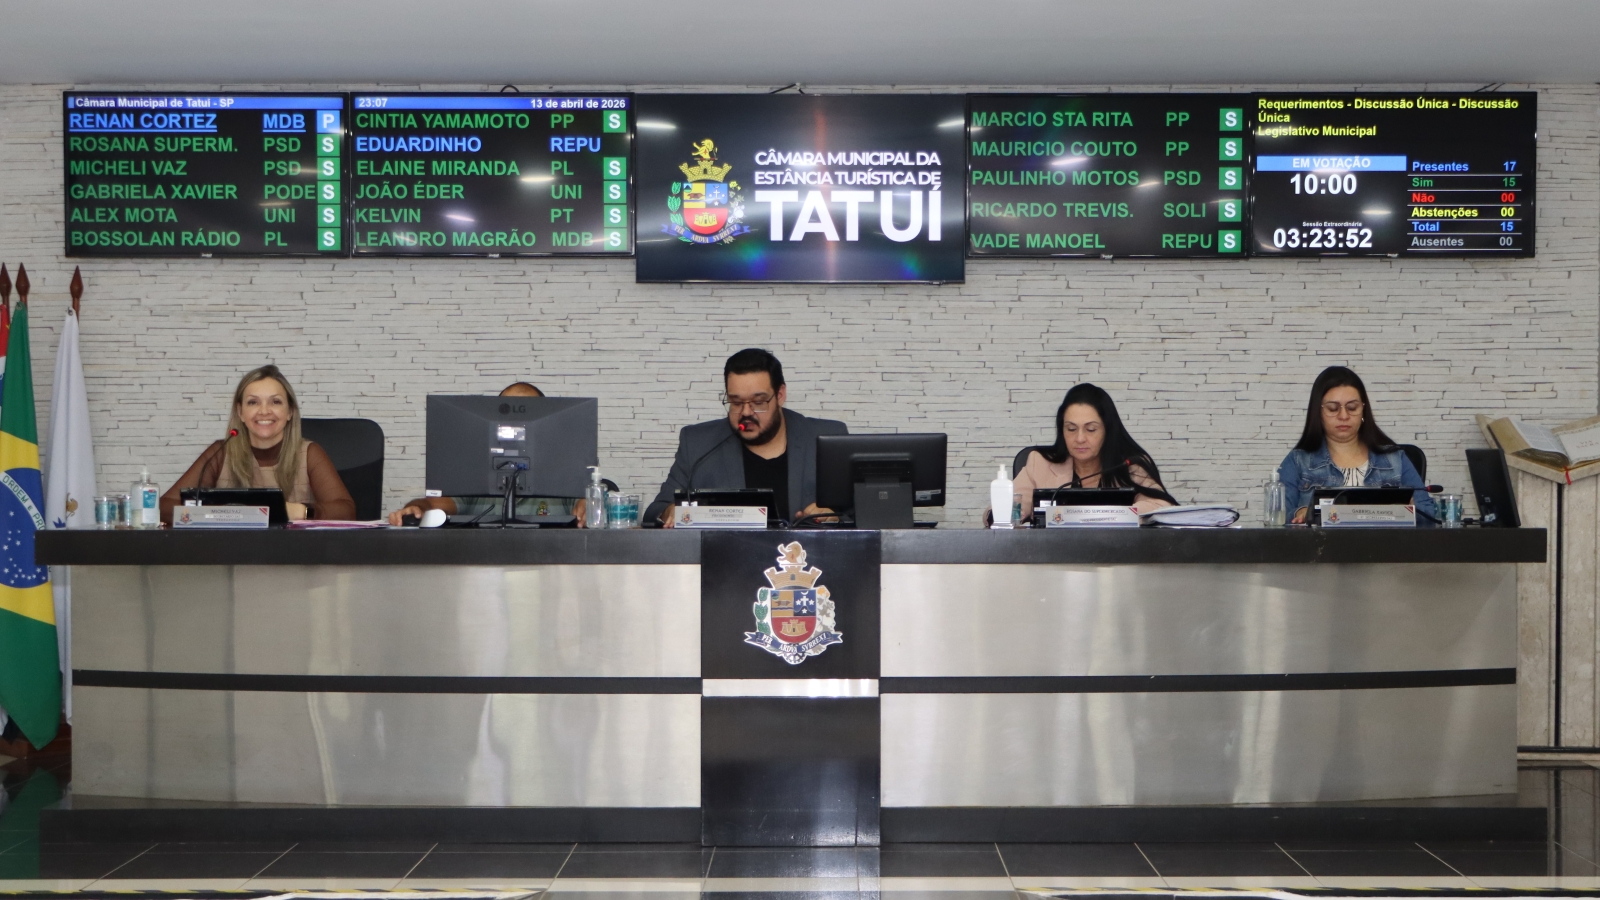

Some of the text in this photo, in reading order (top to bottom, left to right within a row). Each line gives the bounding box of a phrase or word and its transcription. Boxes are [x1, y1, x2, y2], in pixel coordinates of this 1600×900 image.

[75, 98, 115, 108] Câmara
[118, 97, 168, 109] Municipal
[171, 98, 183, 108] de
[186, 98, 211, 108] Tatuí
[220, 98, 234, 108] SP
[359, 98, 626, 108] 23:07 13 de abril de 2026
[1258, 100, 1343, 111] Requerimentos
[1355, 100, 1413, 109] Discussão
[1417, 97, 1448, 109] Única
[1459, 100, 1518, 109] Discussão
[70, 113, 334, 129] RENAN CORTEZ MDB P
[356, 114, 621, 129] CINTIA YAMAMOTO PP S
[972, 112, 1237, 127] MARCIO STA RITA PP S
[1258, 111, 1290, 122] Única
[1258, 126, 1376, 137] Legislativo Municipal
[70, 137, 334, 152] ROSANA SUPERM. PSD S
[356, 137, 600, 152] EDUARDINHO REPU
[972, 141, 1237, 156] MAURICIO COUTO PP S
[755, 149, 941, 166] CÂMARA MUNICIPAL DA
[1293, 156, 1370, 170] EM VOTAÇÃO
[70, 160, 334, 176] MICHELI VAZ PSD S
[357, 161, 621, 176] ELAINE MIRANDA PL S
[1412, 162, 1516, 171] Presentes 17
[755, 168, 941, 185] ESTÂNCIA TURÍSTICA DE
[972, 171, 1236, 186] PAULINHO MOTOS PSD S
[1290, 174, 1357, 194] 10:00
[1412, 178, 1515, 187] Sim 15
[70, 184, 334, 200] GABRIELA XAVIER PODE S
[356, 180, 621, 200] JOÃO ÉDER UNI S
[1412, 193, 1515, 203] Não 00
[70, 208, 334, 223] ALEX MOTA UNI S
[356, 208, 621, 224] KELVIN PT S
[755, 185, 941, 242] TATUÍ
[972, 203, 1236, 218] RICARDO TREVIS. SOLI S
[1412, 208, 1514, 219] Abstenções 00
[1412, 222, 1513, 231] Total 15
[71, 228, 335, 247] BOSSOLAN RÁDIO PL S
[356, 228, 621, 247] LEANDRO MAGRÃO MDB S
[971, 234, 1235, 249] VADE MANOEL REPU S
[1273, 228, 1372, 248] 03:23:52
[1412, 237, 1512, 246] Ausentes 00
[513, 405, 526, 413] LG
[3, 475, 28, 503] ORDEM
[762, 634, 773, 644] PER
